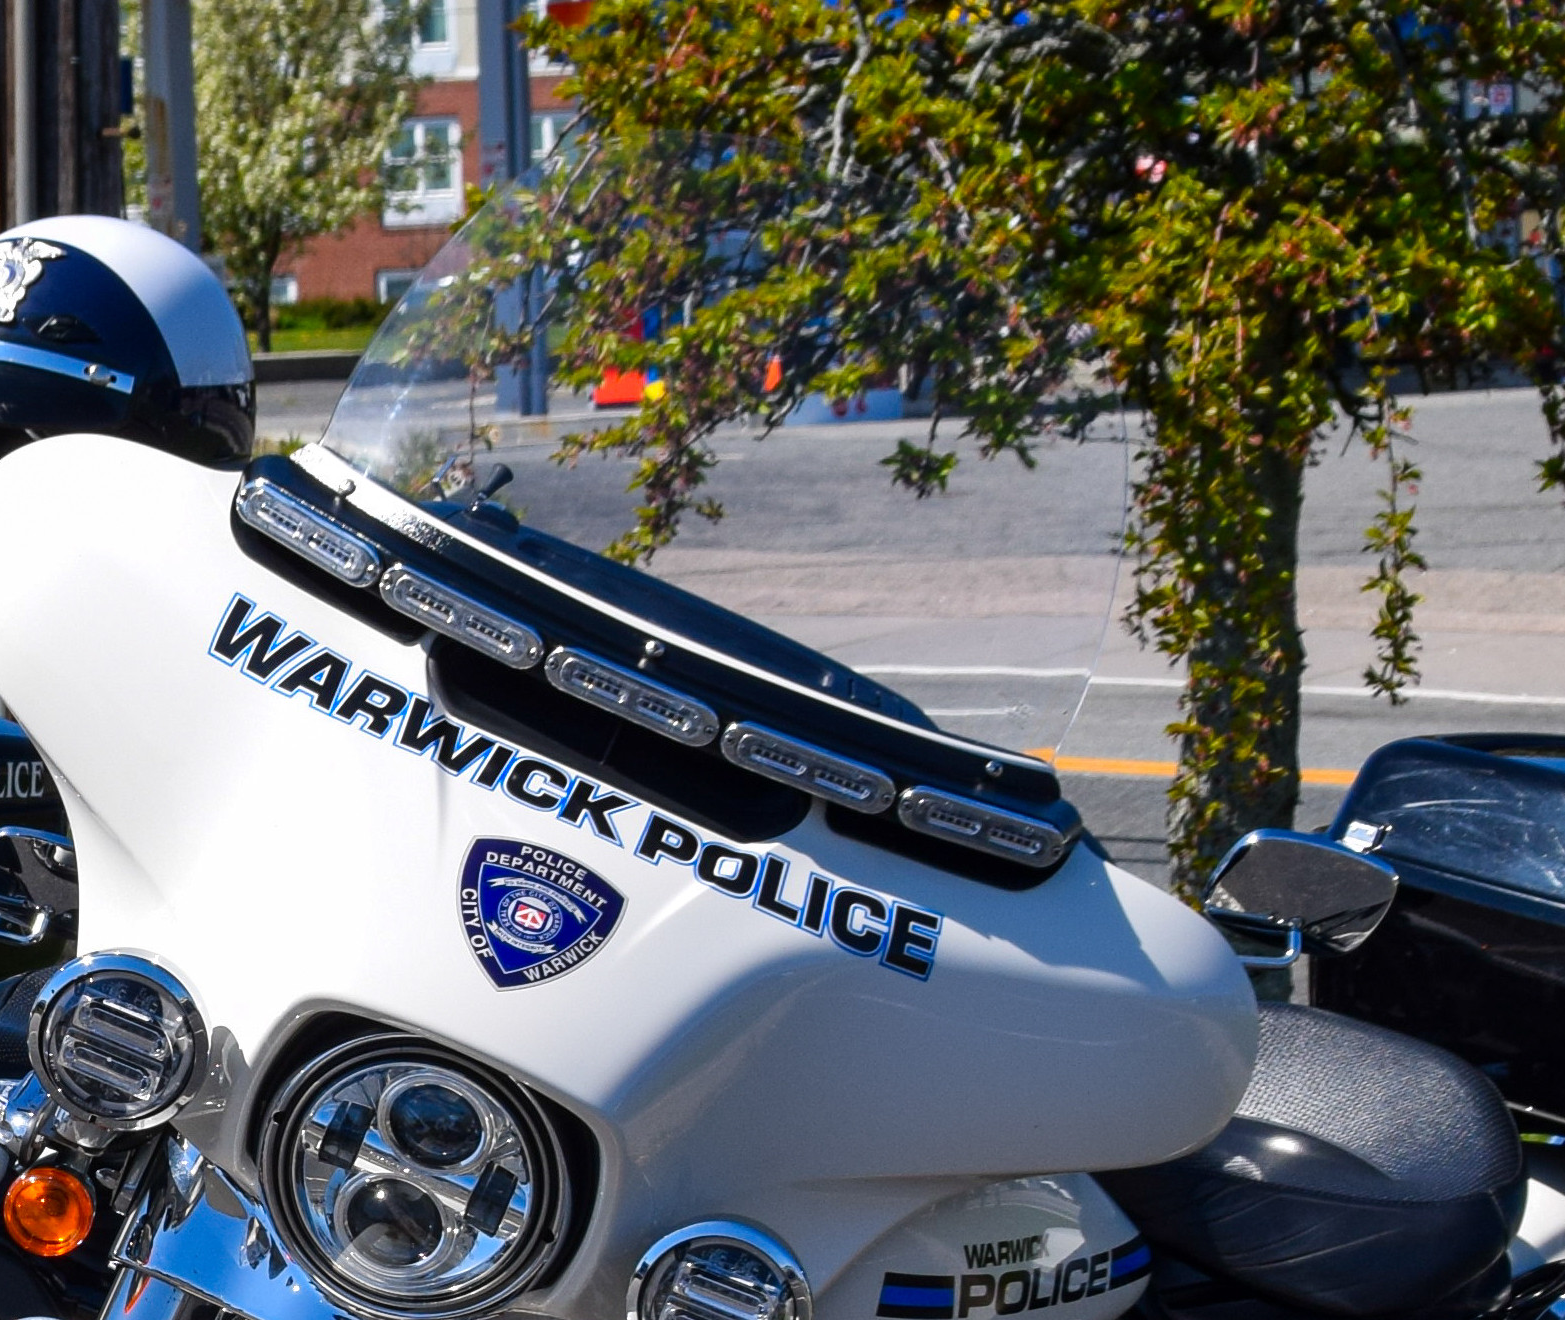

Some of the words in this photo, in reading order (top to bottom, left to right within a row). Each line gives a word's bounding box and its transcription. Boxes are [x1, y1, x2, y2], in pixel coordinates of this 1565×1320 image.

[207, 592, 639, 848] WARWICK
[634, 811, 943, 981] POLICE
[486, 851, 608, 908] DEPARTMENT
[520, 845, 587, 881] POLICE
[461, 888, 481, 929] CITY
[470, 934, 493, 958] OF
[523, 930, 604, 982] WARWICK
[958, 1251, 1109, 1318] POLICE
